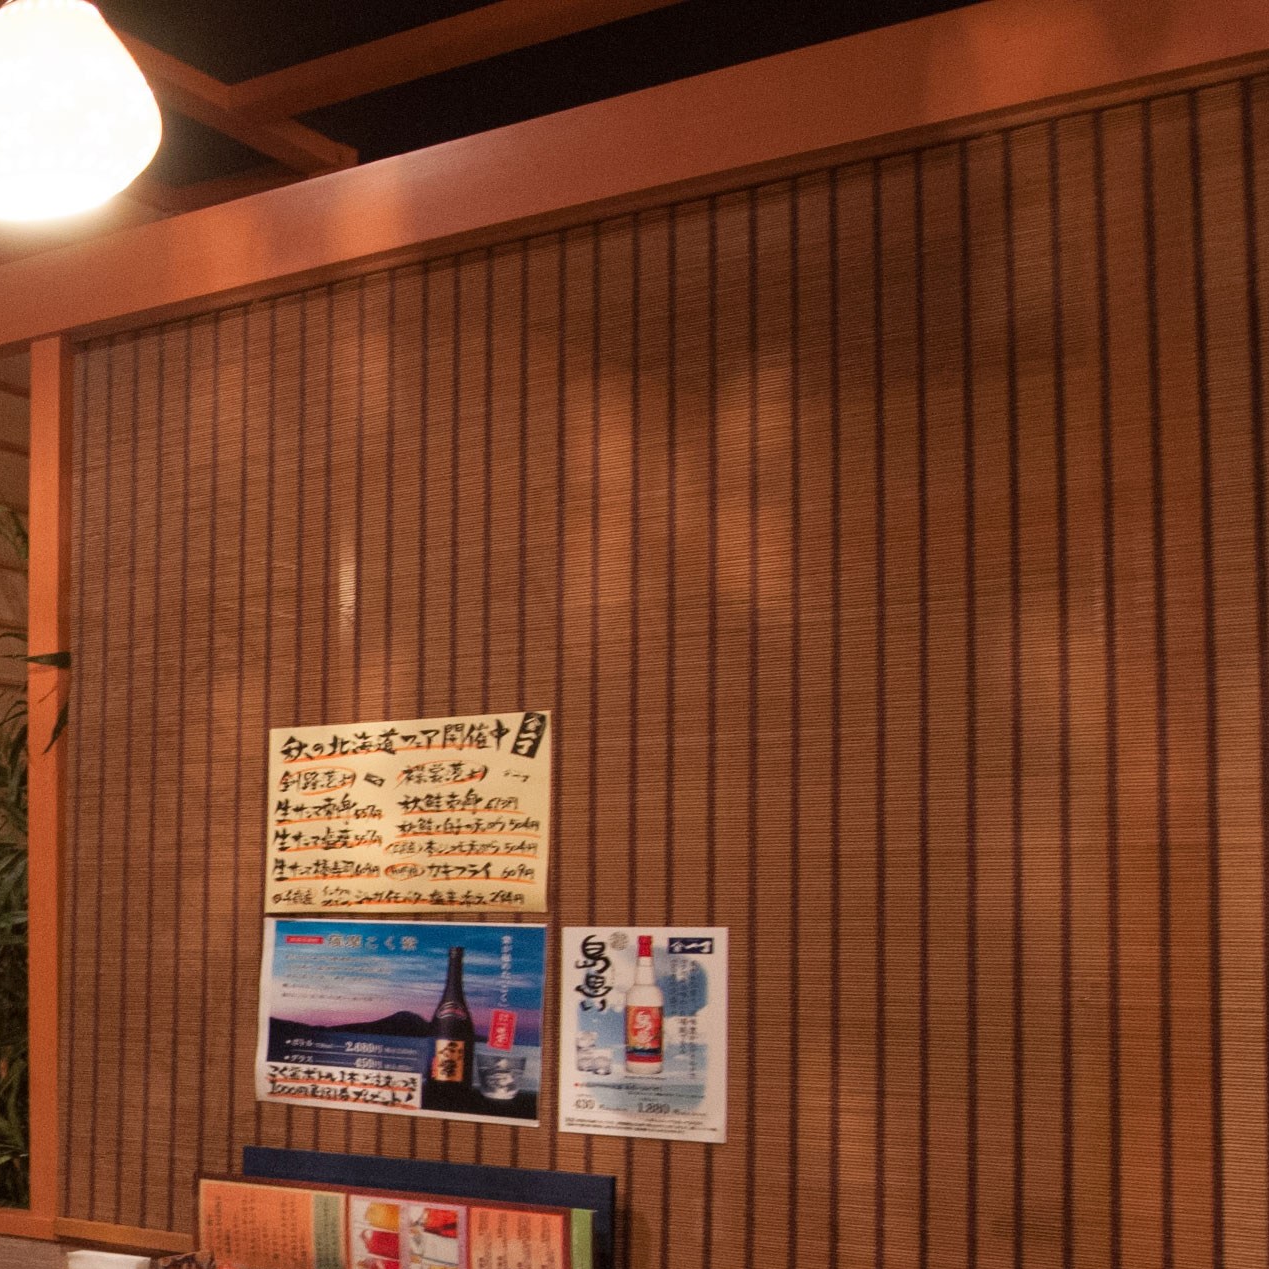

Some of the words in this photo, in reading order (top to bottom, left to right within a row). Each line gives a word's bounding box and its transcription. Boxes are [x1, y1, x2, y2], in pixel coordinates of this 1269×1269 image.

[281, 718, 510, 761] 秋の北海道フェア開催中
[427, 861, 494, 880] カキフライ
